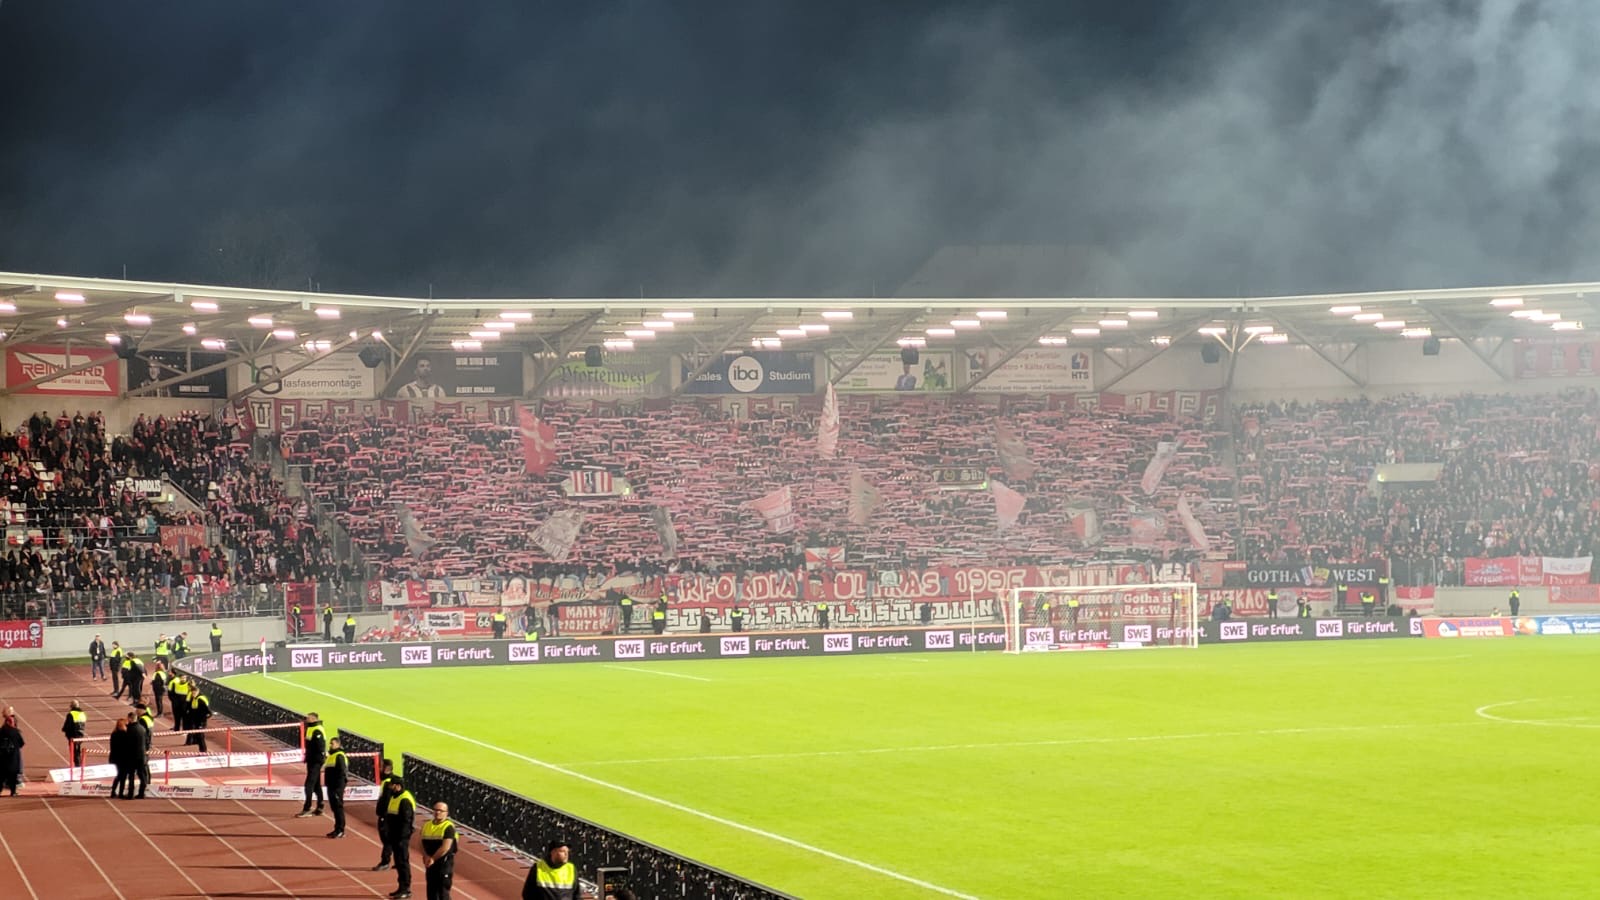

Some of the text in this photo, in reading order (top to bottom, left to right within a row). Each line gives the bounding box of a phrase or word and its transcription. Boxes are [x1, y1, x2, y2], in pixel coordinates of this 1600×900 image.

[733, 364, 759, 381] iba
[769, 370, 811, 381] Studium
[1072, 371, 1089, 379] HTS
[1247, 569, 1300, 583] GOTHA
[1332, 568, 1376, 582] WEST
[1123, 592, 1159, 603] Gotha
[1123, 603, 1173, 615] Rot-Wei
[1127, 627, 1149, 639] SWE
[1156, 627, 1174, 638] Für
[1224, 623, 1303, 636] SWE Für Erfurt.
[1319, 623, 1341, 633] SWE
[1347, 622, 1365, 633] Für
[1366, 621, 1398, 633] Erfurt.
[826, 635, 912, 648] SWE Für Erfurt.
[929, 634, 951, 645] SWE
[1029, 629, 1111, 642] SWE Für Erfurt.
[512, 644, 601, 658] SWE Für Erfurt.
[618, 641, 706, 654] SWE Für Erfurt.
[723, 638, 810, 651] SWE Für Erfurt.
[295, 650, 386, 664] SWE Für Erfurt.
[404, 647, 494, 660] SWE Für Erfurt.
